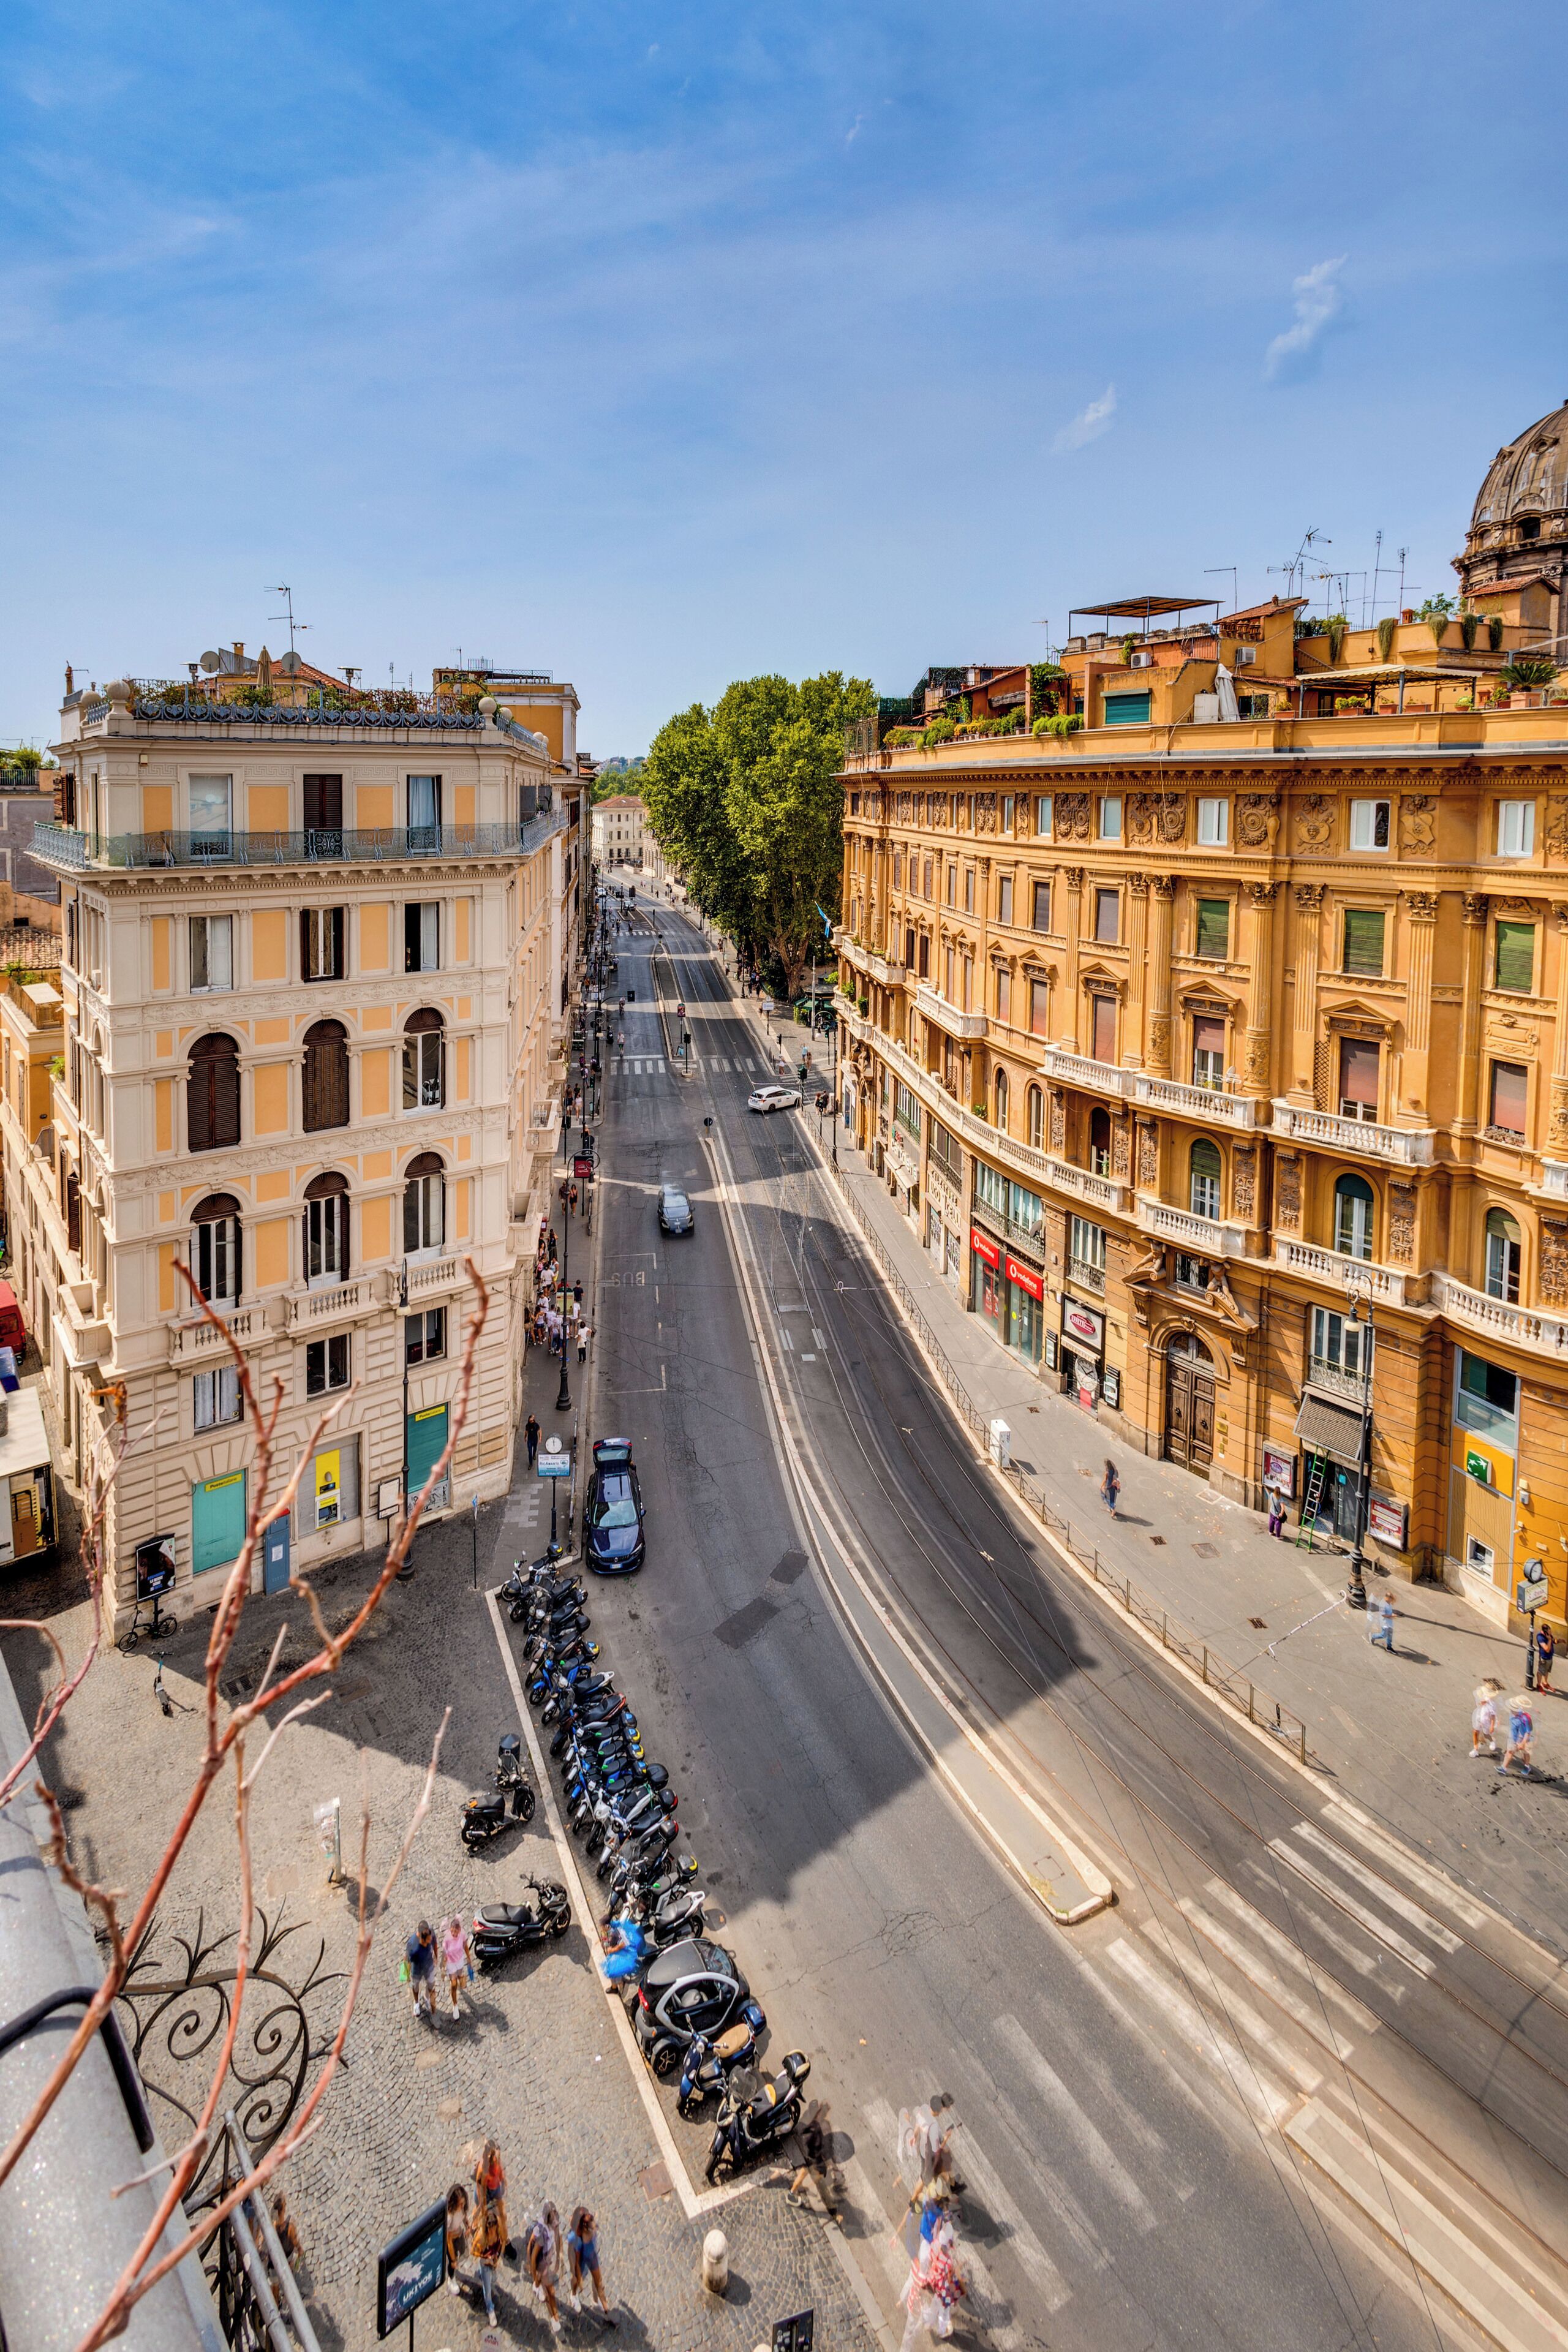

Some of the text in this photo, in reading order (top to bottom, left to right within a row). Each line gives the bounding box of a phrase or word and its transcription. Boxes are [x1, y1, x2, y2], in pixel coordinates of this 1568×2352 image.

[979, 1242, 995, 1259] vodafone
[611, 1271, 645, 1287] BUS
[1017, 1272, 1037, 1289] vodafone
